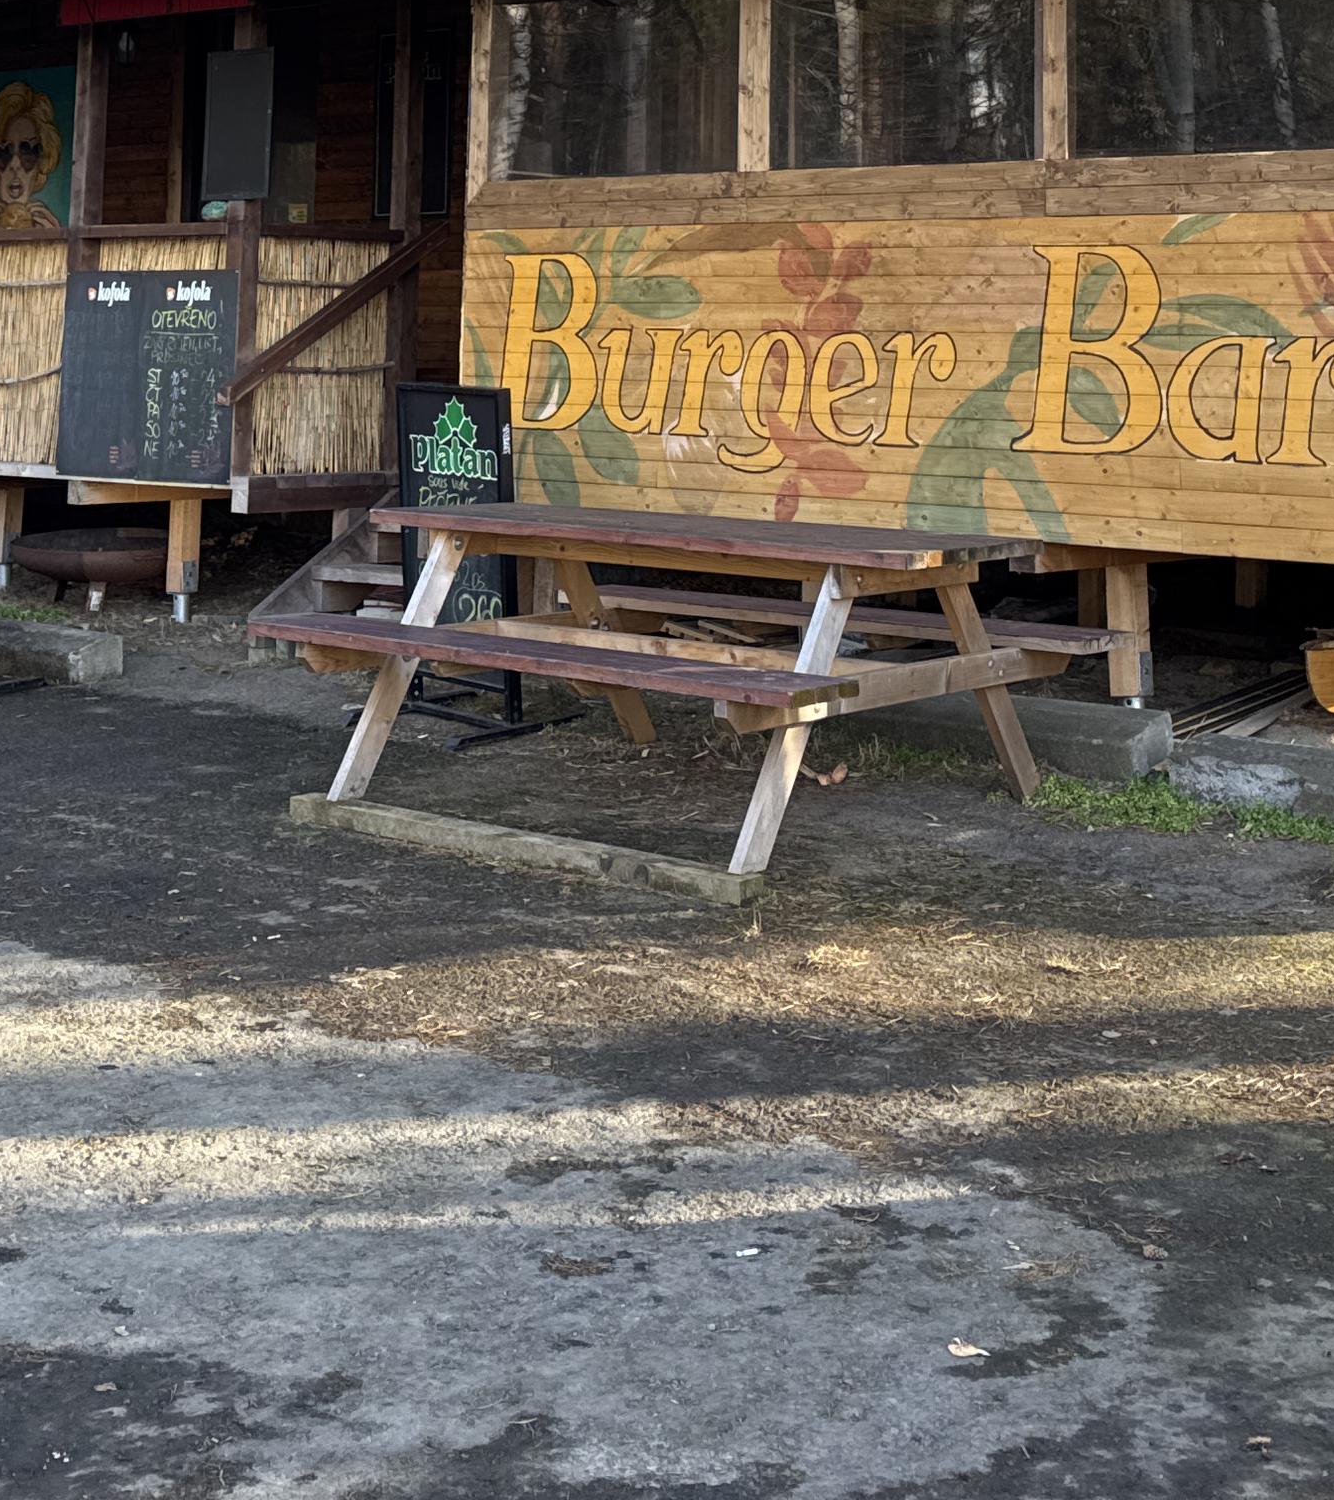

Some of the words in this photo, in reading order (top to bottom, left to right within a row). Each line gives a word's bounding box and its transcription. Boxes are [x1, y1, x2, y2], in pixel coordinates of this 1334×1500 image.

[97, 281, 131, 307] kofola
[176, 280, 212, 307] kofola
[147, 367, 163, 384] ST
[501, 252, 958, 474] Burger
[145, 420, 161, 439] SO
[409, 434, 498, 481] Platan
